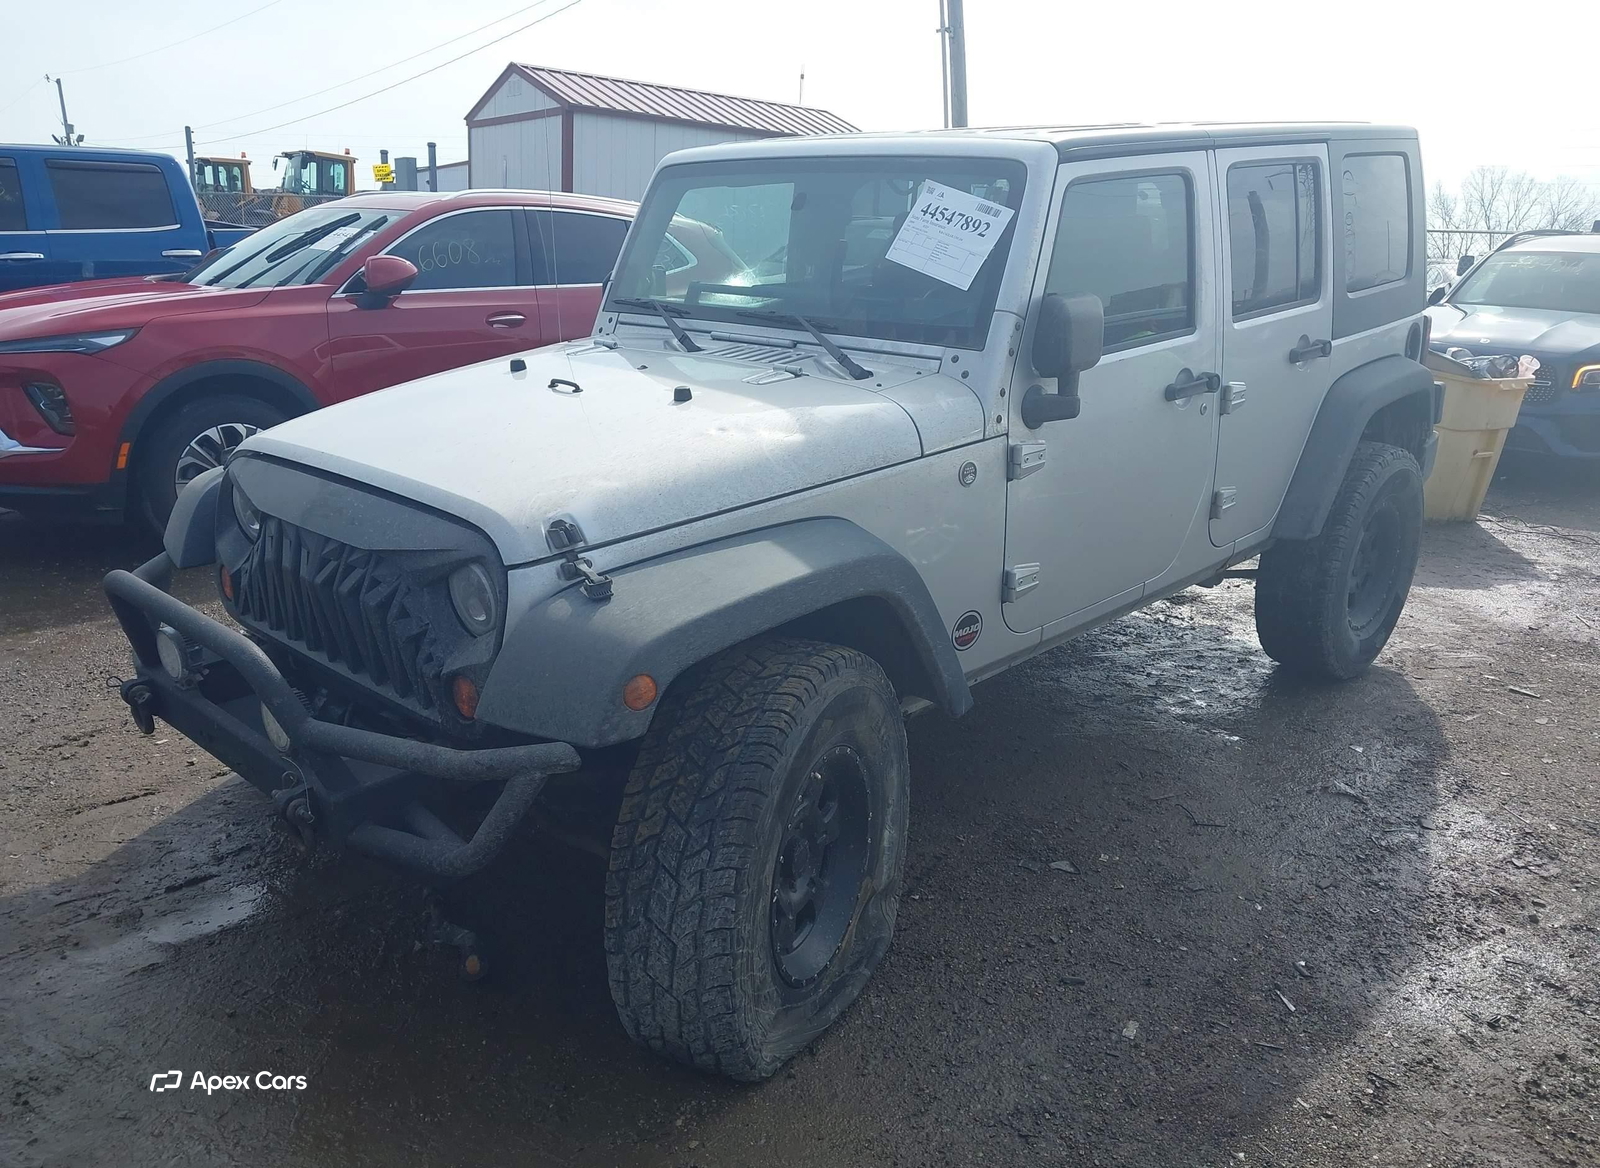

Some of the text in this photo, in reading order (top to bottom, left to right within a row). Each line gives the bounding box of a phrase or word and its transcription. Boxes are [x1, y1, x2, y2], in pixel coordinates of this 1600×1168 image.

[920, 202, 991, 238] 44547892
[418, 238, 481, 272] 6608
[955, 622, 980, 638] MOJO
